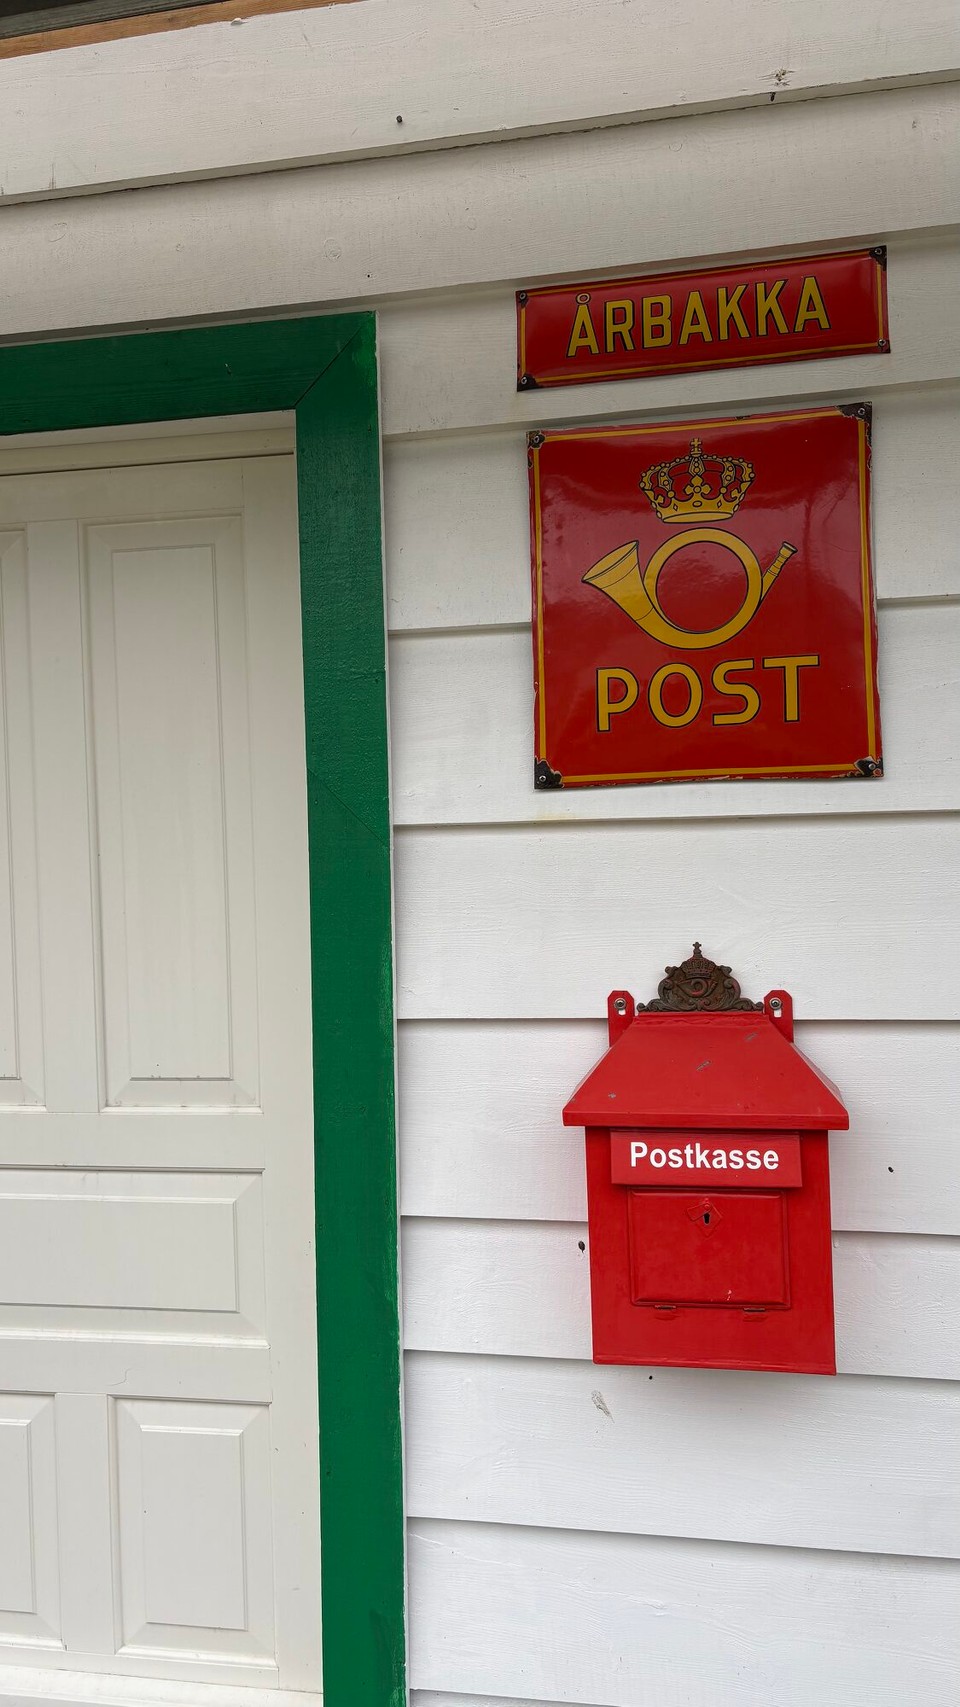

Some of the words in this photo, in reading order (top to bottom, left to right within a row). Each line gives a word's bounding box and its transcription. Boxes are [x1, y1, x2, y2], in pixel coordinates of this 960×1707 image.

[566, 276, 831, 358] ÅRBAKKA
[596, 655, 820, 732] POST
[630, 1141, 779, 1170] Postkasse
